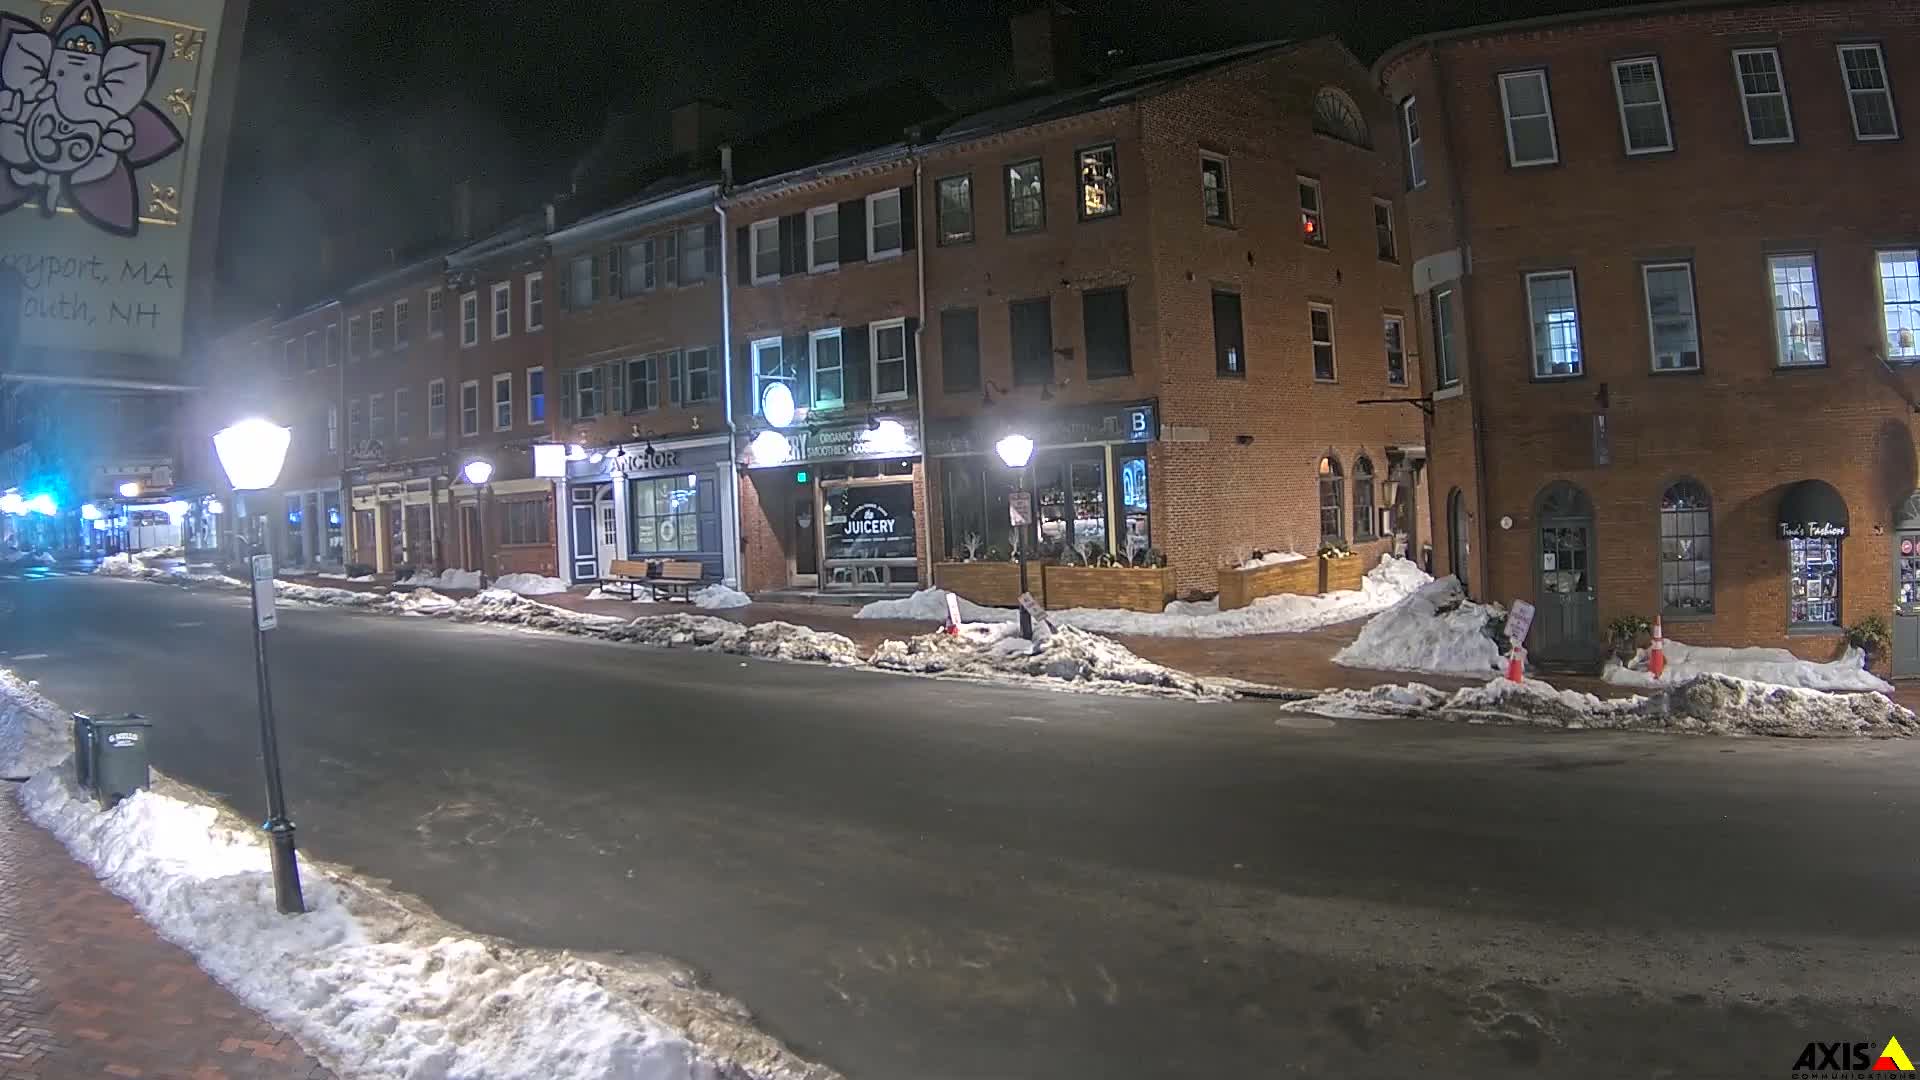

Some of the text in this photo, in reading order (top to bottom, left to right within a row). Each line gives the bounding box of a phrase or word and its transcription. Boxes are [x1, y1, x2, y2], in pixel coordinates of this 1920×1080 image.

[120, 259, 174, 289] MA
[108, 299, 161, 329] NH
[1132, 412, 1146, 431] B
[820, 431, 851, 444] ORGANIC
[611, 451, 677, 472] ANCHOR
[844, 518, 895, 535] JUICERY
